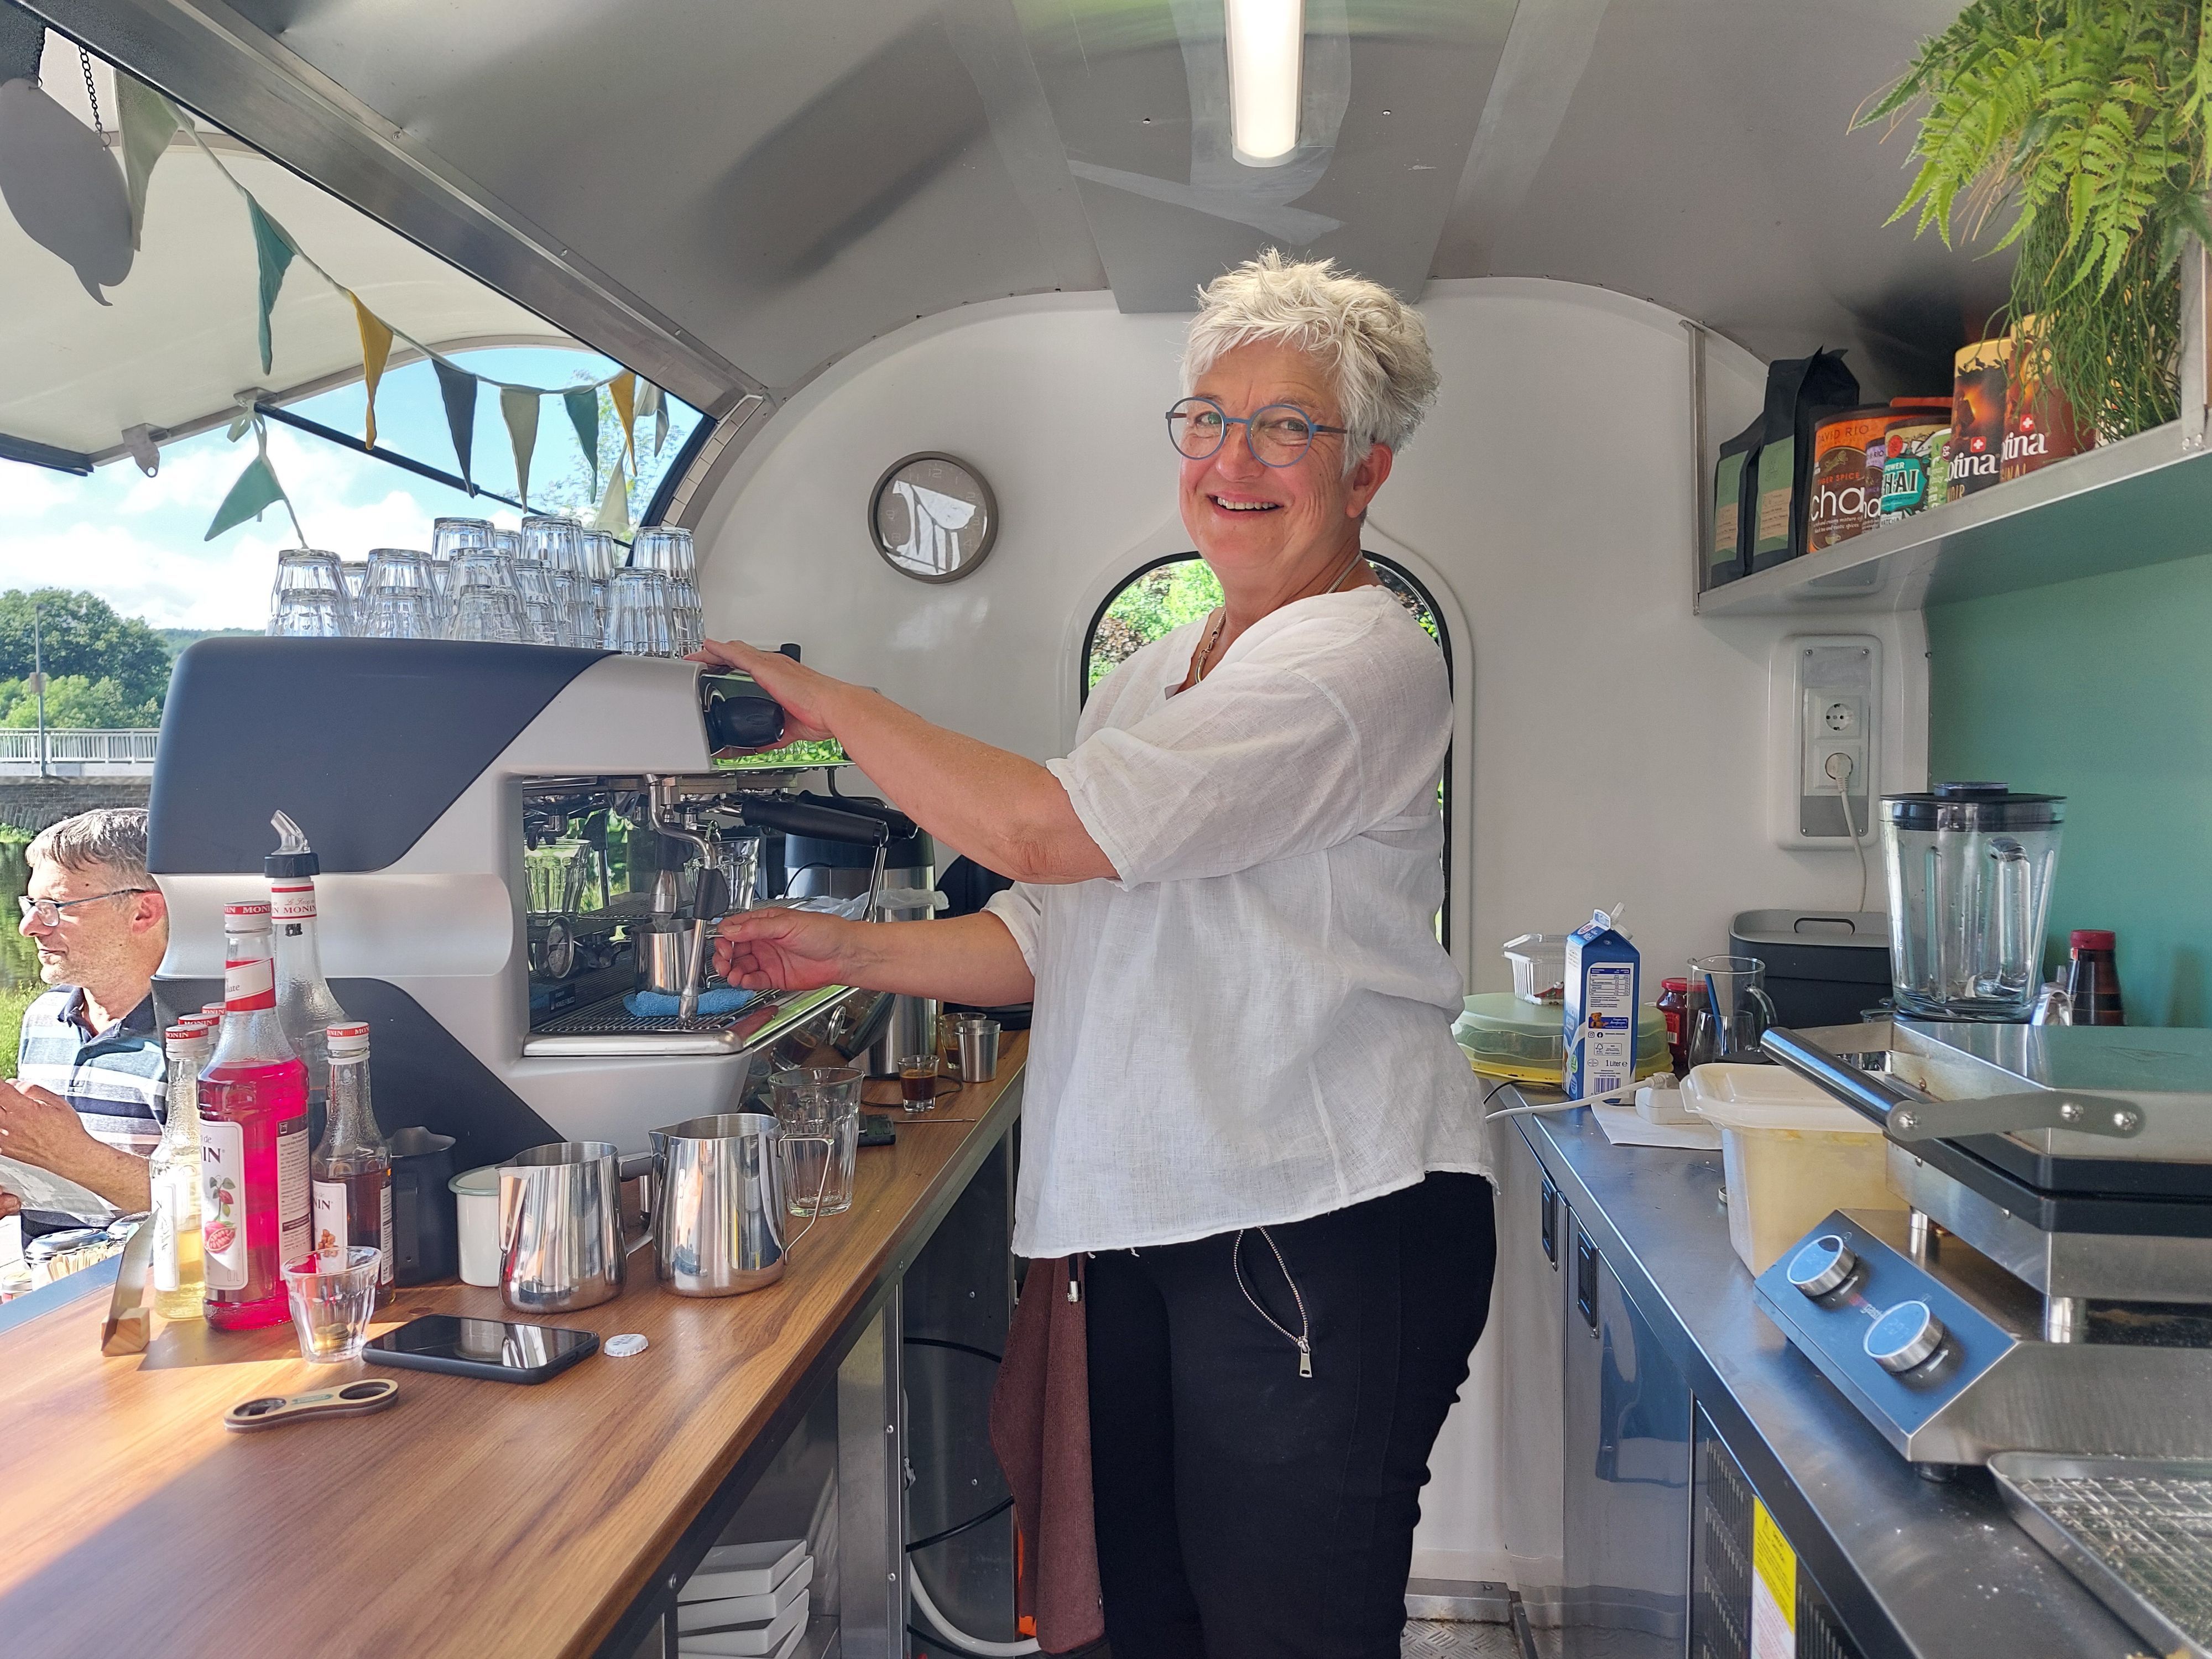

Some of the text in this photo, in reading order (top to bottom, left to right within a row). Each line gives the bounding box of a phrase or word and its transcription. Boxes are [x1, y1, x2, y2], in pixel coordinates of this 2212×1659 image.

[1845, 425, 1869, 436] RIO
[928, 468, 942, 478] 12
[1836, 472, 1860, 482] SPICE
[1881, 468, 1919, 496] HAI
[283, 905, 316, 914] MONIN
[204, 1135, 212, 1144] de
